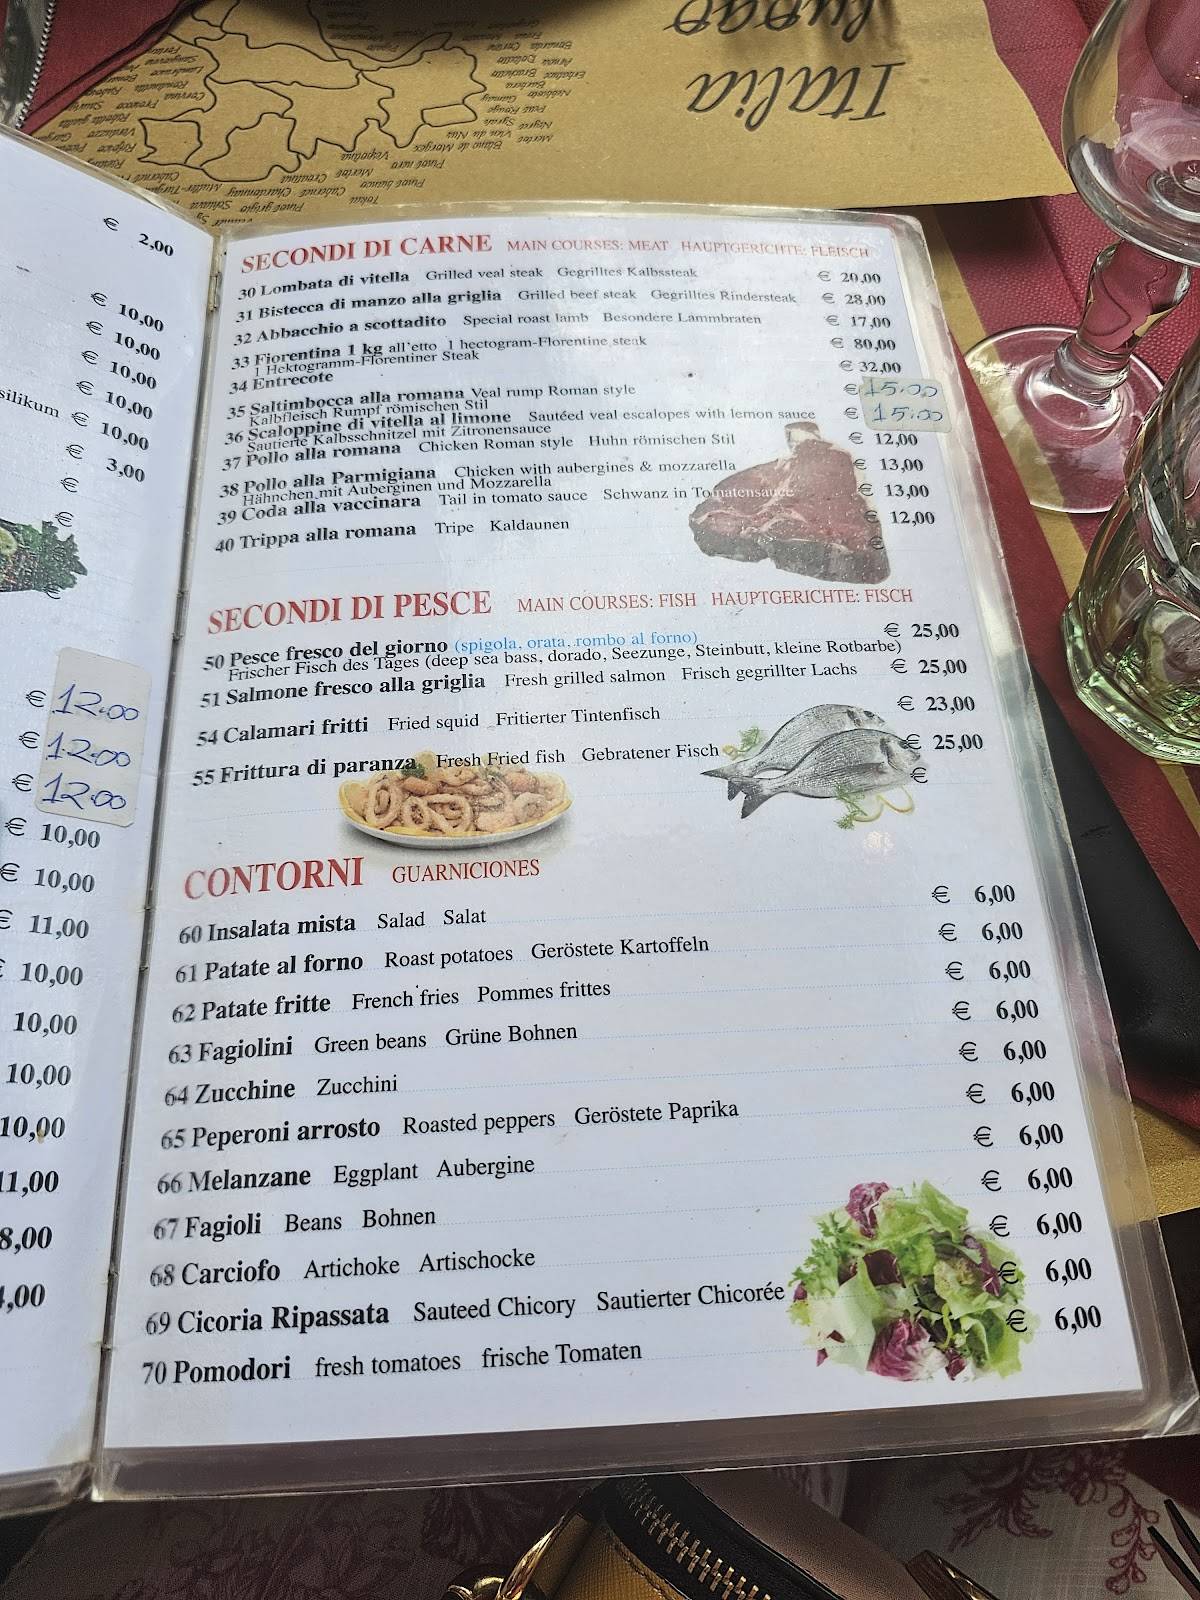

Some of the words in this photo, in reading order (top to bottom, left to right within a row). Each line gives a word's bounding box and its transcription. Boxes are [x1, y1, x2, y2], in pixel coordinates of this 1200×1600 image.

[685, 61, 906, 132] Italia
[226, 187, 292, 198] Chardonnay
[139, 234, 173, 256] 2,00
[242, 243, 354, 273] SECONDI
[364, 240, 390, 257] DI
[400, 235, 492, 255] CARNE
[508, 240, 546, 251] MAIN
[551, 238, 624, 252] COURSES:
[629, 240, 668, 250] MEAT
[682, 240, 807, 256] HAUPTGERICHTE:
[811, 246, 868, 256] FLEISCH
[261, 279, 332, 295] Lombata
[360, 272, 409, 284] vitella
[426, 270, 472, 280] Grilled
[478, 269, 504, 278] veal
[510, 268, 542, 277] steak
[841, 273, 880, 283] 20,00
[260, 304, 323, 318] Bistecca
[352, 297, 406, 308] manzo
[412, 292, 441, 304] alla
[448, 290, 501, 304] griglia
[651, 290, 715, 301] Gegrilltes
[720, 291, 797, 303] Rindersteak
[845, 294, 885, 305] 28,00
[120, 304, 163, 331] 10,00
[256, 322, 344, 344] Abbacchio
[365, 316, 446, 329] scottadito
[852, 316, 890, 328] 17,00
[854, 339, 895, 352] 80,00
[252, 371, 334, 391] Entrecote
[860, 362, 901, 373] 32,00
[250, 395, 354, 417] Saltimbocca
[398, 391, 464, 401] romana
[472, 388, 500, 398] Veal
[507, 389, 543, 398] rump
[549, 386, 597, 395] Roman
[604, 384, 635, 397] style
[452, 412, 510, 424] limone
[590, 435, 627, 446] Huhn
[633, 434, 705, 445] römischen
[712, 434, 734, 444] Stil
[876, 433, 917, 447] 12,00
[106, 458, 145, 482] 3,00
[332, 467, 436, 484] Parmigiana
[333, 496, 420, 511] vaccinara
[692, 485, 795, 499] Tomatensauce
[892, 511, 934, 526] 12,00
[240, 534, 299, 549] Trippa
[346, 526, 416, 538] romana
[435, 522, 473, 536] Tripe
[491, 520, 568, 531] Kaldaunen
[208, 598, 342, 633] SECONDI
[351, 596, 384, 620] DI
[394, 591, 491, 617] PESCE
[518, 597, 563, 612] MAIN
[570, 595, 653, 610] COURSES:
[660, 593, 696, 607] FISH
[711, 590, 860, 606] HAUPTGERICHTE:
[865, 589, 912, 602] FISCH
[912, 624, 959, 640] 25,00
[230, 649, 280, 668] Pesce
[286, 646, 343, 663] fresco
[350, 641, 378, 656] del
[385, 639, 448, 658] giorno
[576, 634, 625, 646] rombo
[650, 629, 698, 646] forno)
[227, 687, 308, 704] Salmone
[811, 663, 857, 675] Lachs
[926, 697, 975, 714] 23,00
[224, 720, 314, 743] Calamari
[322, 717, 367, 734] fritti
[388, 716, 430, 730] Fried
[437, 714, 478, 731] squid
[496, 710, 567, 728] Fritierter
[571, 707, 660, 722] Tintenfisch
[933, 734, 983, 752] 25,00
[220, 765, 300, 783] Frittura
[307, 759, 325, 775] di
[334, 759, 416, 777] paranza
[582, 748, 670, 761] Gebratener
[676, 744, 719, 757] Fisch
[41, 824, 100, 848] 10,00
[185, 857, 364, 899] CONTORNI
[393, 859, 539, 883] GUARNICIONES
[975, 885, 1015, 906] 6,00
[29, 915, 89, 939] 11,00
[208, 920, 289, 941] Insalata
[298, 915, 356, 934] mista
[378, 911, 425, 929] Salad
[444, 909, 486, 924] Salat
[205, 960, 269, 980] Patate
[304, 954, 363, 972] forno
[385, 952, 434, 967] Roast
[441, 949, 512, 969] potatoes
[532, 943, 614, 959] Geröstete
[620, 936, 709, 954] Kartoffeln
[202, 999, 267, 1020] Patate
[275, 995, 330, 1014] fritte
[352, 991, 413, 1009] French
[420, 989, 459, 1005] fries
[478, 987, 553, 1002] Pommes
[560, 981, 610, 997] frittes
[199, 1036, 292, 1064] Fagiolini
[315, 1037, 368, 1053] Green
[376, 1034, 426, 1049] beans
[446, 1029, 501, 1045] Grüne
[508, 1024, 577, 1042] Bohnen
[1004, 1040, 1046, 1064] 6,00
[196, 1080, 295, 1103] Zucchine
[317, 1076, 396, 1095] Zucchini
[0, 1116, 65, 1142] 10,00
[193, 1121, 289, 1151] Peperoni
[298, 1118, 380, 1140] arrosto
[189, 1169, 310, 1192] Melanzane
[334, 1163, 418, 1187] Eggplant
[437, 1156, 534, 1179] Aubergine
[1028, 1167, 1072, 1193] 6,00
[185, 1213, 261, 1242] Fagioli
[285, 1214, 341, 1232] Beans
[362, 1208, 435, 1228] Bohnen
[182, 1259, 280, 1285] Carciofo
[419, 1248, 535, 1272] Artischocke
[178, 1308, 262, 1333] Cicoria
[272, 1304, 389, 1334] Ripassata
[698, 1282, 784, 1304] Chicorée
[1055, 1306, 1101, 1334] 6,00
[173, 1356, 290, 1383] Pomodori
[315, 1356, 364, 1376] fresh
[372, 1355, 460, 1374] tomatoes
[555, 1344, 642, 1363] Tomaten
